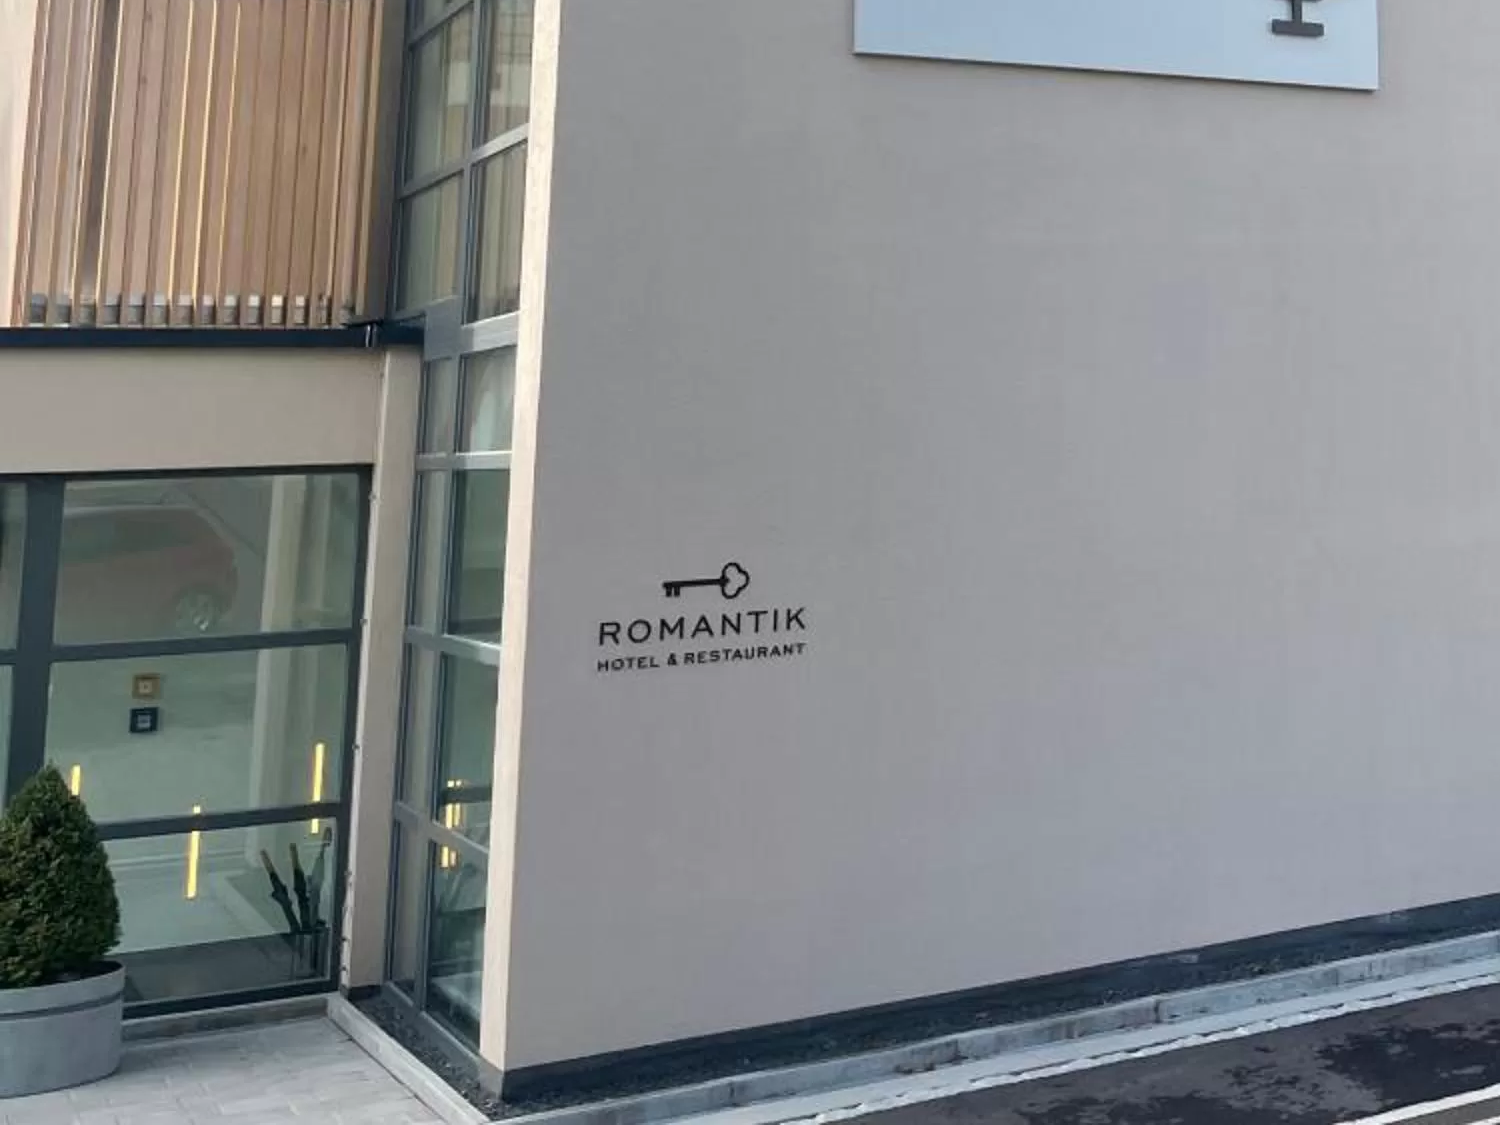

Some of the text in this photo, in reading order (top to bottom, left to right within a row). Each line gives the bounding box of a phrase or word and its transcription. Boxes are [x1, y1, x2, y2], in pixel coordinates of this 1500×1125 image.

[598, 607, 807, 646] ROMANTIK
[597, 642, 807, 672] HOTEL & RESTAURANT
